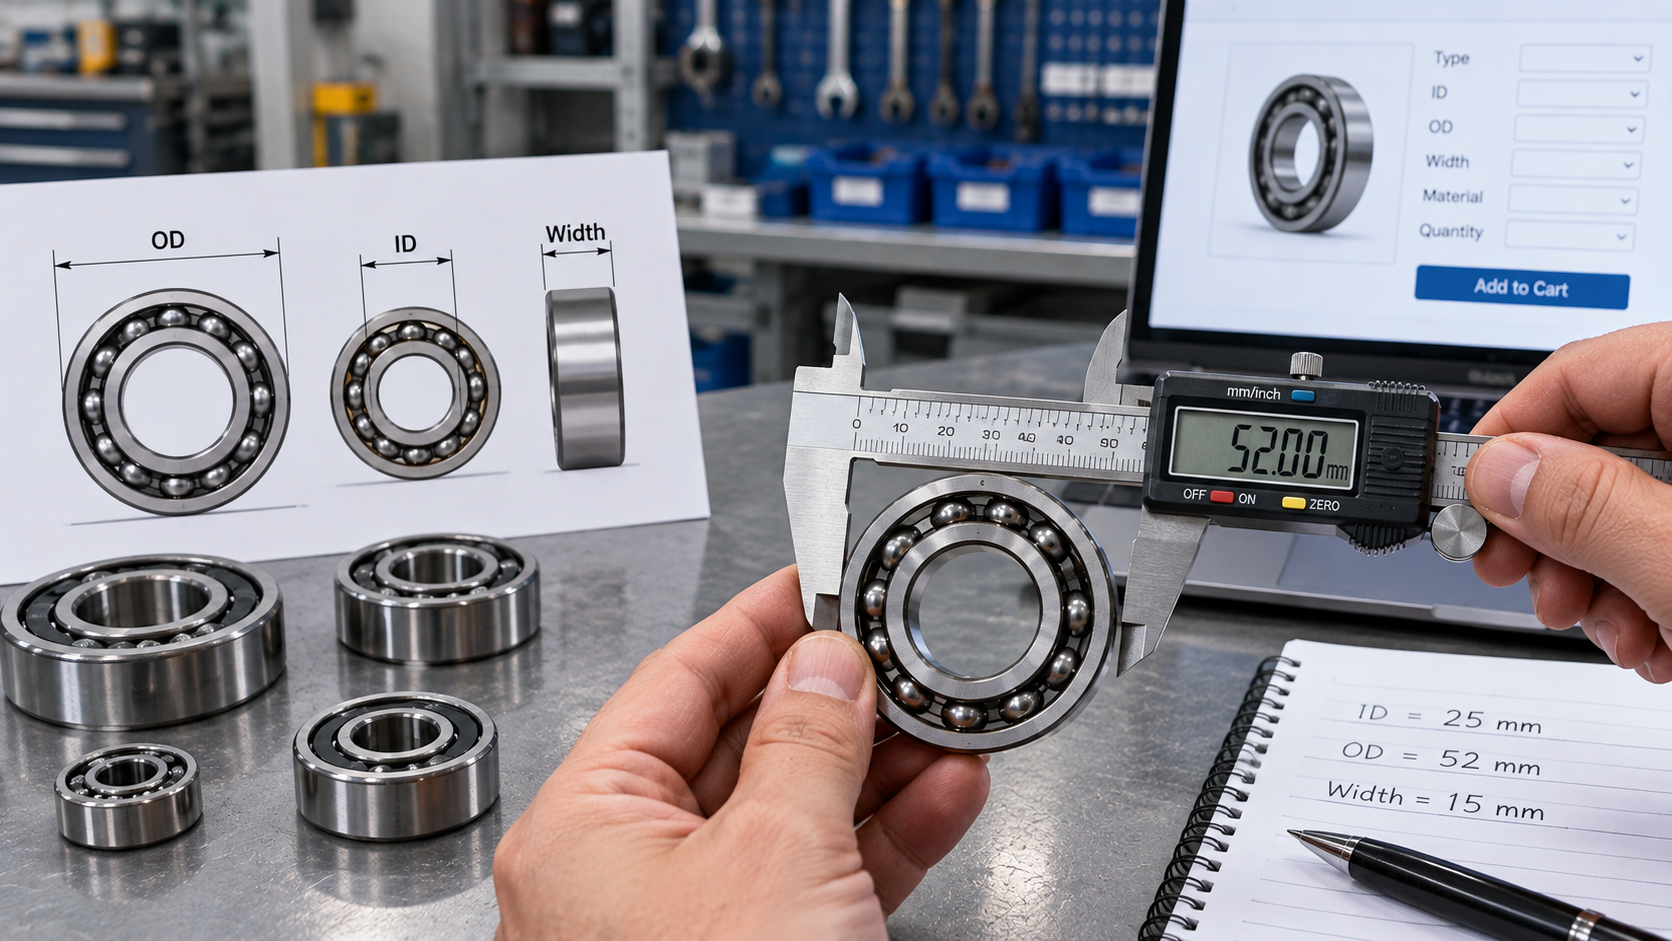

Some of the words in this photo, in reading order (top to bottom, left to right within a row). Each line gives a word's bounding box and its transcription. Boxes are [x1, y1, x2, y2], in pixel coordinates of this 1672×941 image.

[1434, 50, 1470, 68] Type
[1431, 86, 1448, 99] ID
[1428, 119, 1453, 134] OD
[1426, 154, 1470, 168] Width
[1422, 189, 1483, 203] Material
[151, 230, 185, 250] OD
[546, 222, 606, 243] Width
[1419, 223, 1484, 241] Quantity
[395, 234, 417, 253] ID
[1474, 278, 1508, 295] Add
[1512, 279, 1529, 296] to
[1533, 280, 1569, 298] Cart
[1227, 386, 1281, 400] mm/inch
[852, 418, 862, 430] 0
[892, 422, 909, 433] 10
[937, 426, 955, 437] 20
[1228, 424, 1328, 479] 52.00
[1326, 463, 1349, 480] mm
[1183, 487, 1207, 501] OFF
[1238, 493, 1257, 506] ON
[1309, 497, 1341, 512] ZERO
[1358, 703, 1388, 721] ID
[1443, 709, 1484, 728] 25
[1496, 719, 1542, 734] mm
[1342, 742, 1384, 760] OD
[1403, 751, 1418, 761] =
[1439, 750, 1480, 770] 52
[1494, 760, 1541, 776] mm
[1327, 781, 1403, 805] Width
[1416, 795, 1430, 806] =
[1448, 793, 1483, 813] 15
[1495, 803, 1544, 821] mm
